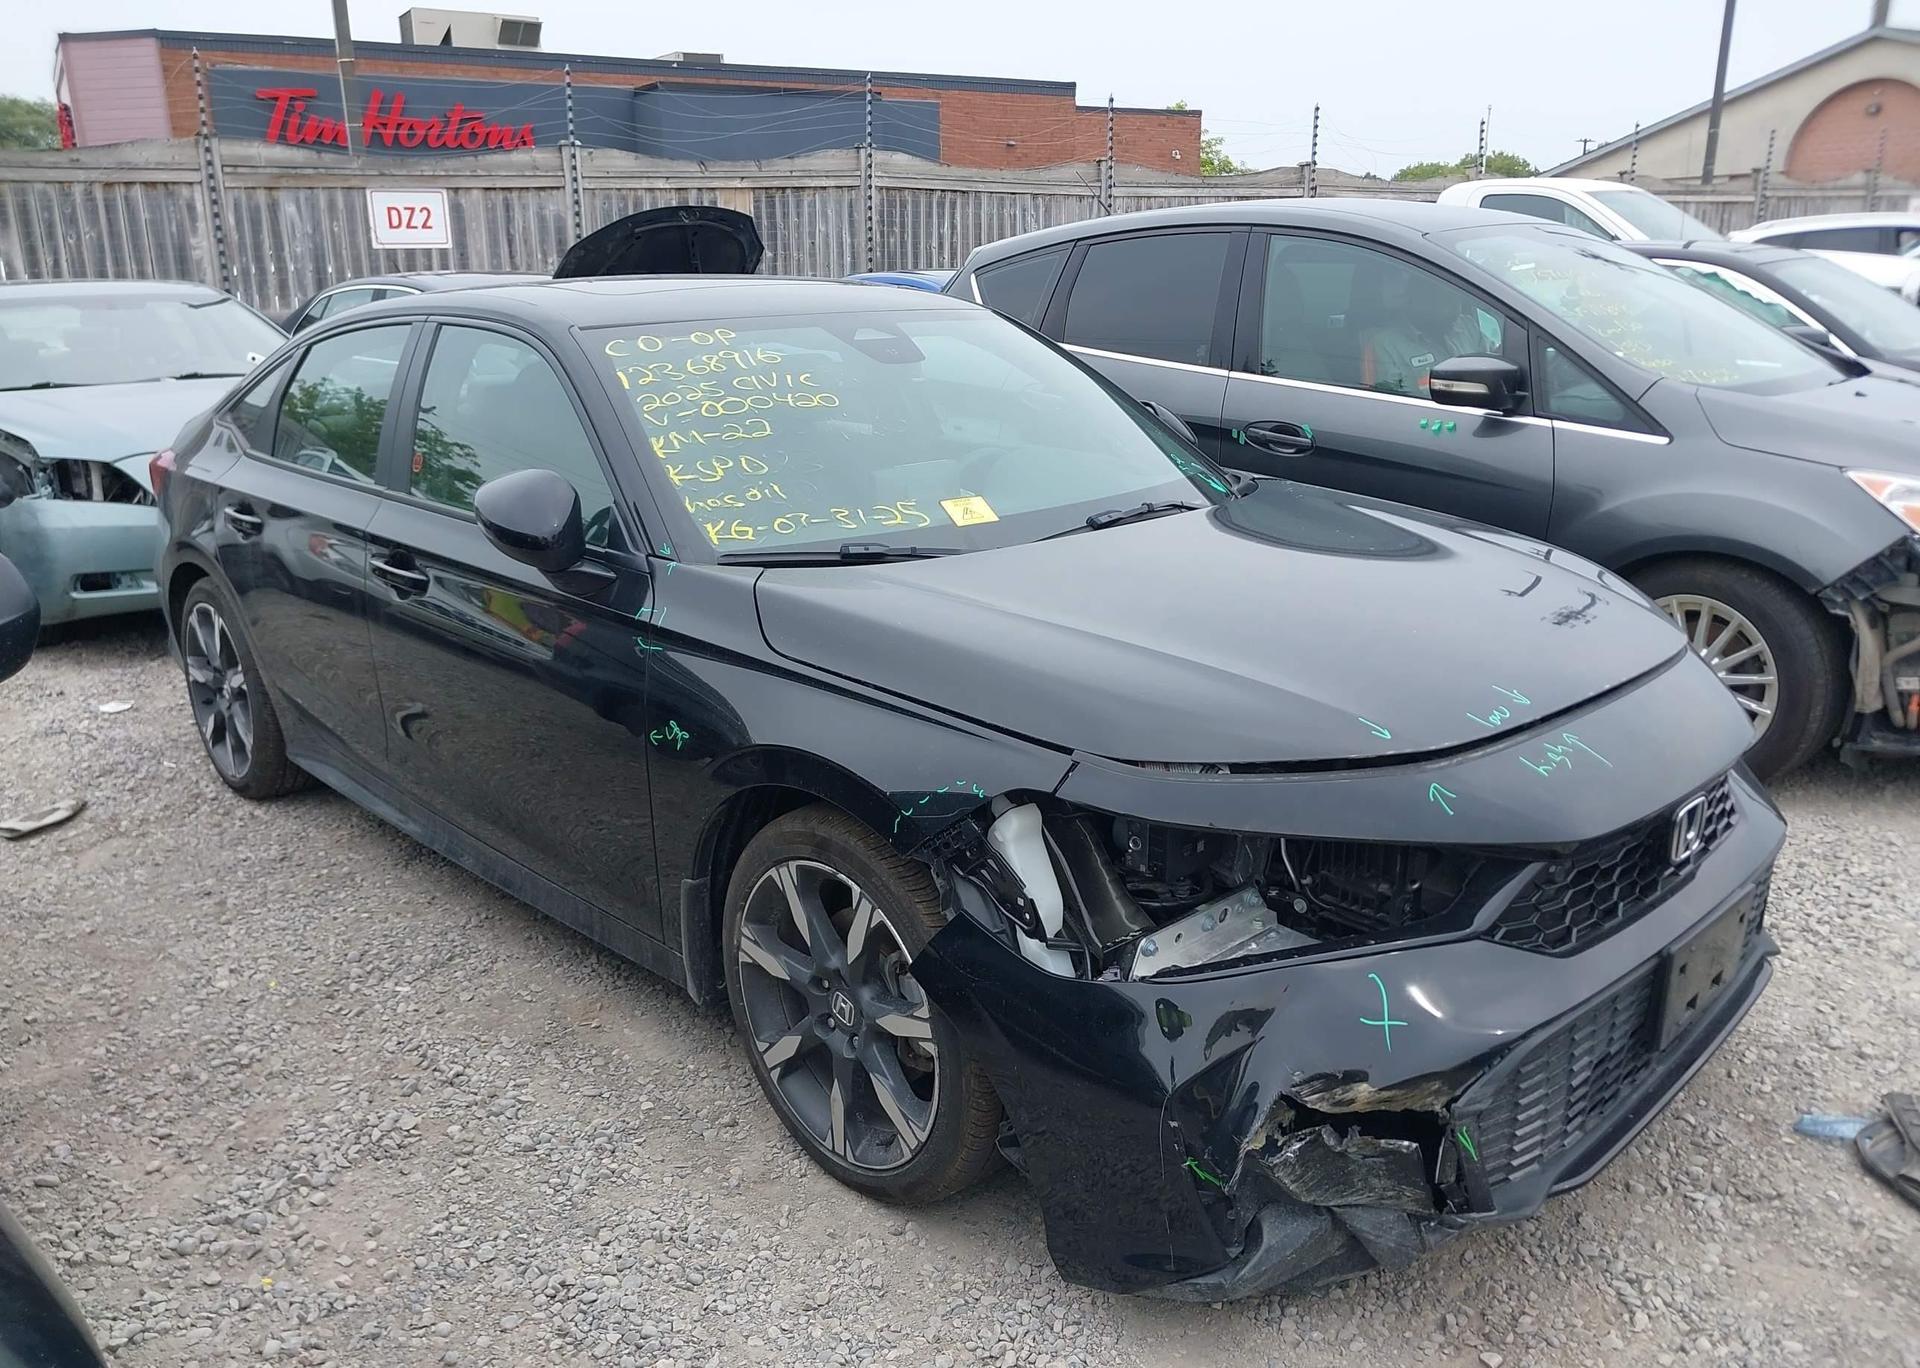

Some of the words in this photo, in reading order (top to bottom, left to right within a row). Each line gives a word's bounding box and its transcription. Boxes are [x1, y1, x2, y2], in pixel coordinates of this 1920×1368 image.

[255, 88, 349, 147] Tim
[361, 86, 536, 151] Hortons
[386, 205, 434, 230] DZ2
[616, 347, 789, 390] 12368916
[636, 380, 725, 412] 2025
[732, 371, 821, 390] CIVIC
[649, 418, 774, 459] KM-22
